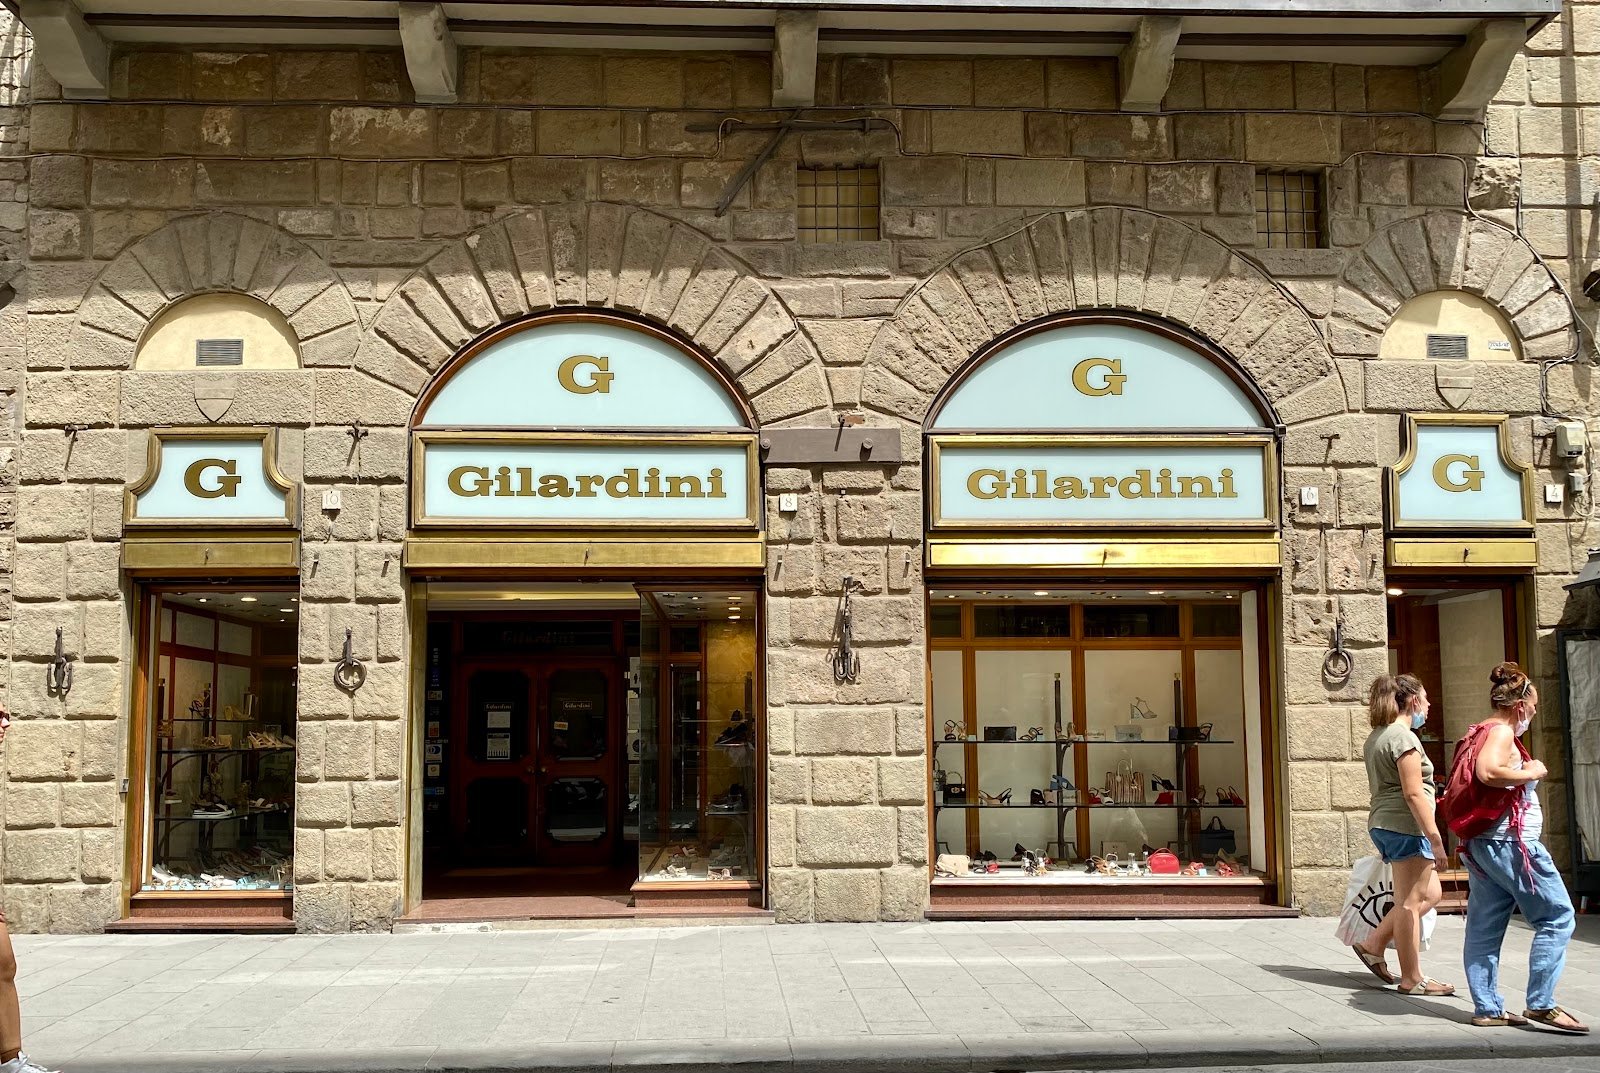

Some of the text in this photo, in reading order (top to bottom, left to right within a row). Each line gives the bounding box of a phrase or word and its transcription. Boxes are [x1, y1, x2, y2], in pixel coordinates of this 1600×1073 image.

[558, 355, 614, 394] G
[1072, 358, 1127, 396] G
[184, 459, 241, 498] G
[448, 466, 726, 499] Gilardini
[967, 468, 1237, 500] Gilardini
[1433, 454, 1484, 493] G
